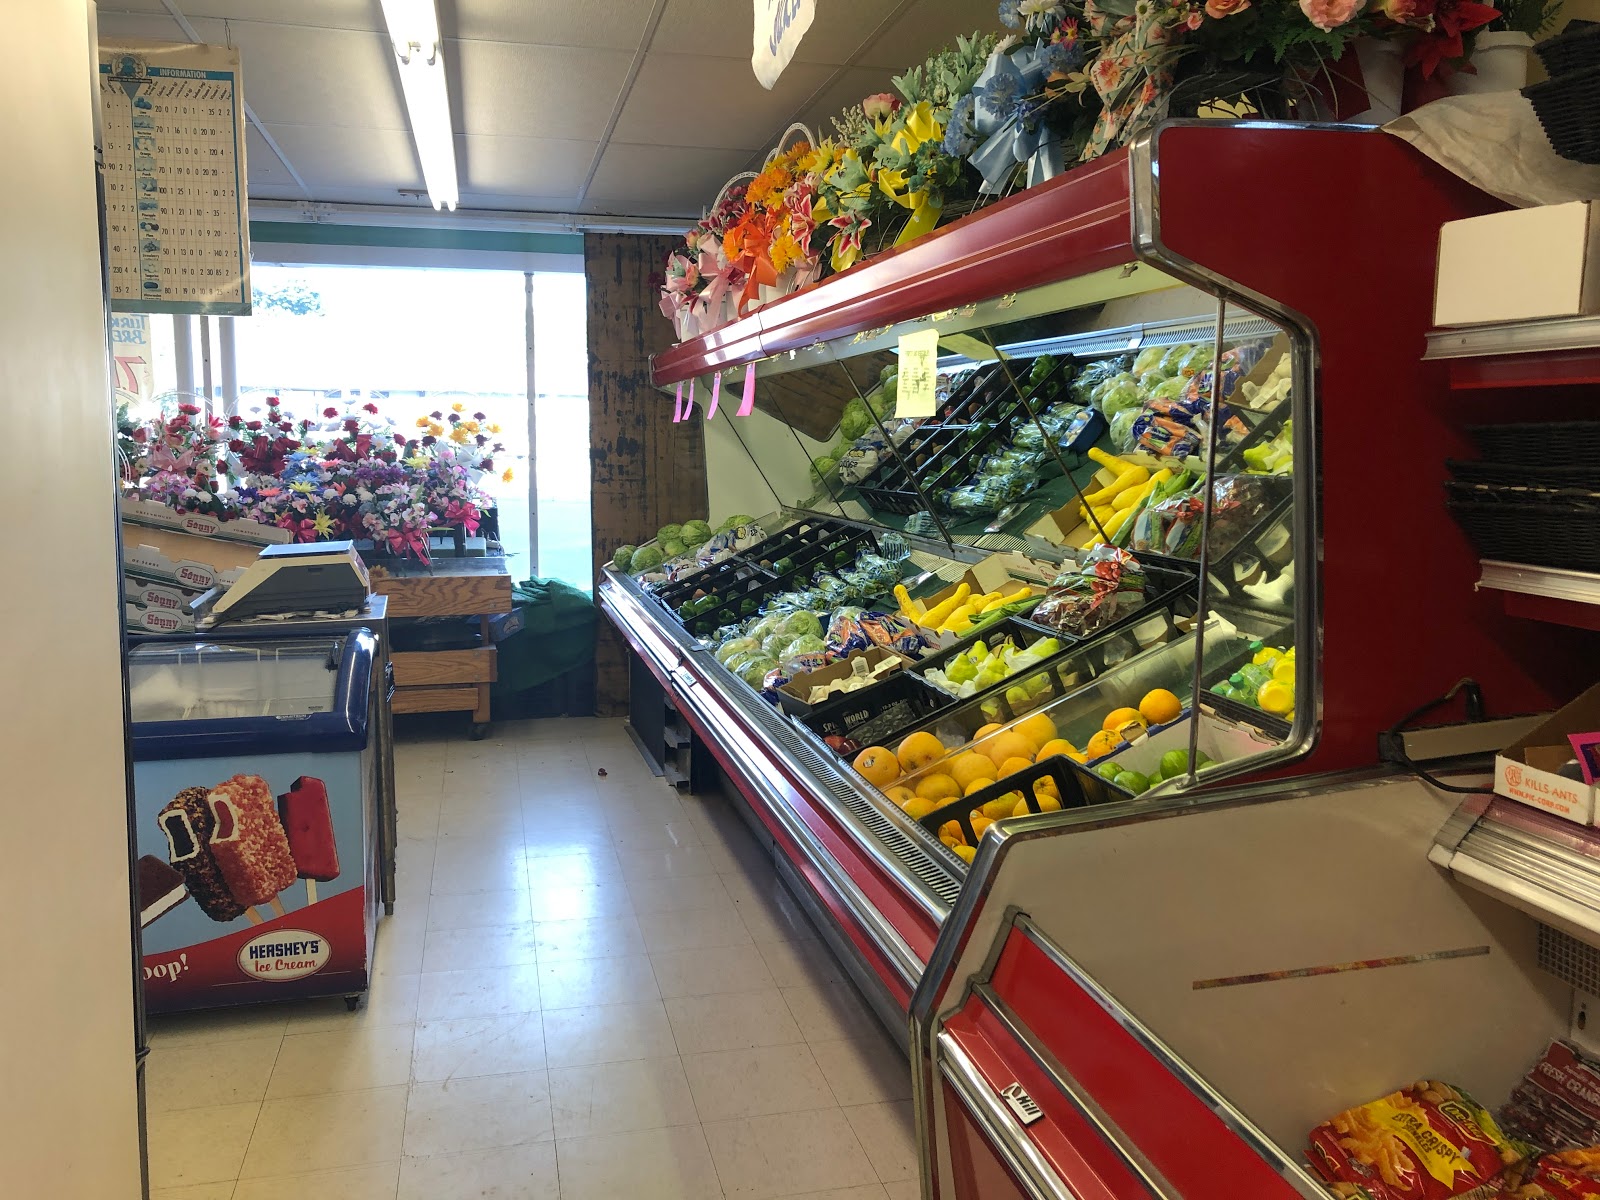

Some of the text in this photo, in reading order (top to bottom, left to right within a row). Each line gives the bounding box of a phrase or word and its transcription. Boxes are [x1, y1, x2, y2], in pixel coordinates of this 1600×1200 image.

[160, 68, 207, 79] INFORMATION
[843, 709, 869, 725] WORLD
[1525, 778, 1578, 804] KILLS ANTS
[250, 940, 319, 959] HERSHEY'S
[255, 959, 317, 972] Ice Cream
[1540, 1062, 1567, 1085] FRESH
[1016, 1095, 1040, 1116] Hill
[1421, 1130, 1461, 1164] CRISPY
